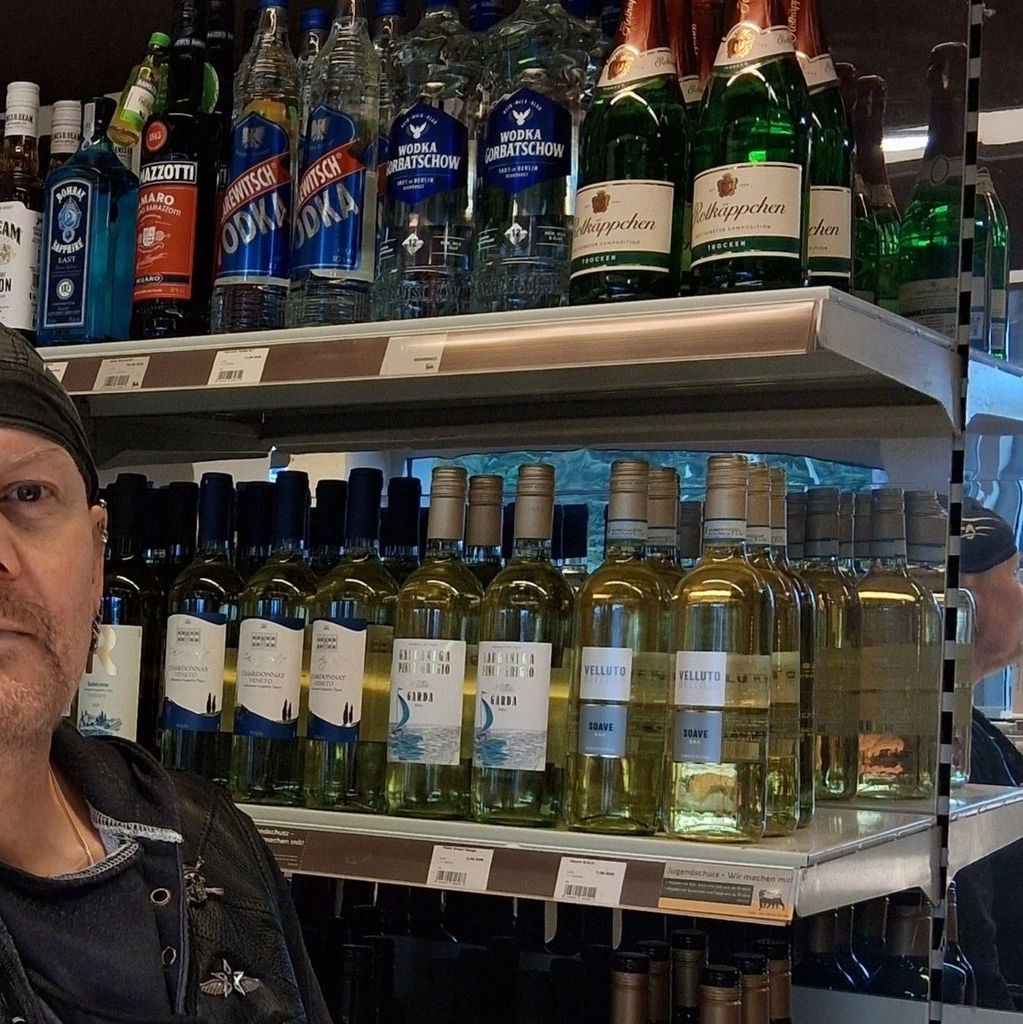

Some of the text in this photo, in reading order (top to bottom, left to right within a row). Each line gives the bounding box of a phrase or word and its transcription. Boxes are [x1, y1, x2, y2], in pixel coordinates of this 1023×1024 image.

[500, 128, 542, 143] WODKA
[398, 141, 438, 157] WODKA
[485, 141, 565, 164] GORBATSCHOW
[55, 185, 87, 204] BOMBAY
[693, 196, 787, 225] Rotkäppchen
[511, 227, 521, 238] 12
[51, 237, 85, 255] SAPPHIRE
[408, 238, 418, 248] 12
[707, 240, 747, 252] TROCKEN
[58, 255, 77, 264] EAST
[581, 255, 617, 265] TROCKEN
[583, 664, 627, 677] VELLUTO
[678, 670, 721, 683] VELLUTO
[406, 690, 434, 703] GARDA
[489, 694, 518, 707] GARDA
[588, 721, 614, 732] SOAVE
[683, 728, 709, 739] SOAVE
[667, 866, 720, 879] Jugendschutz
[727, 871, 742, 880] Wir
[743, 874, 776, 883] machen
